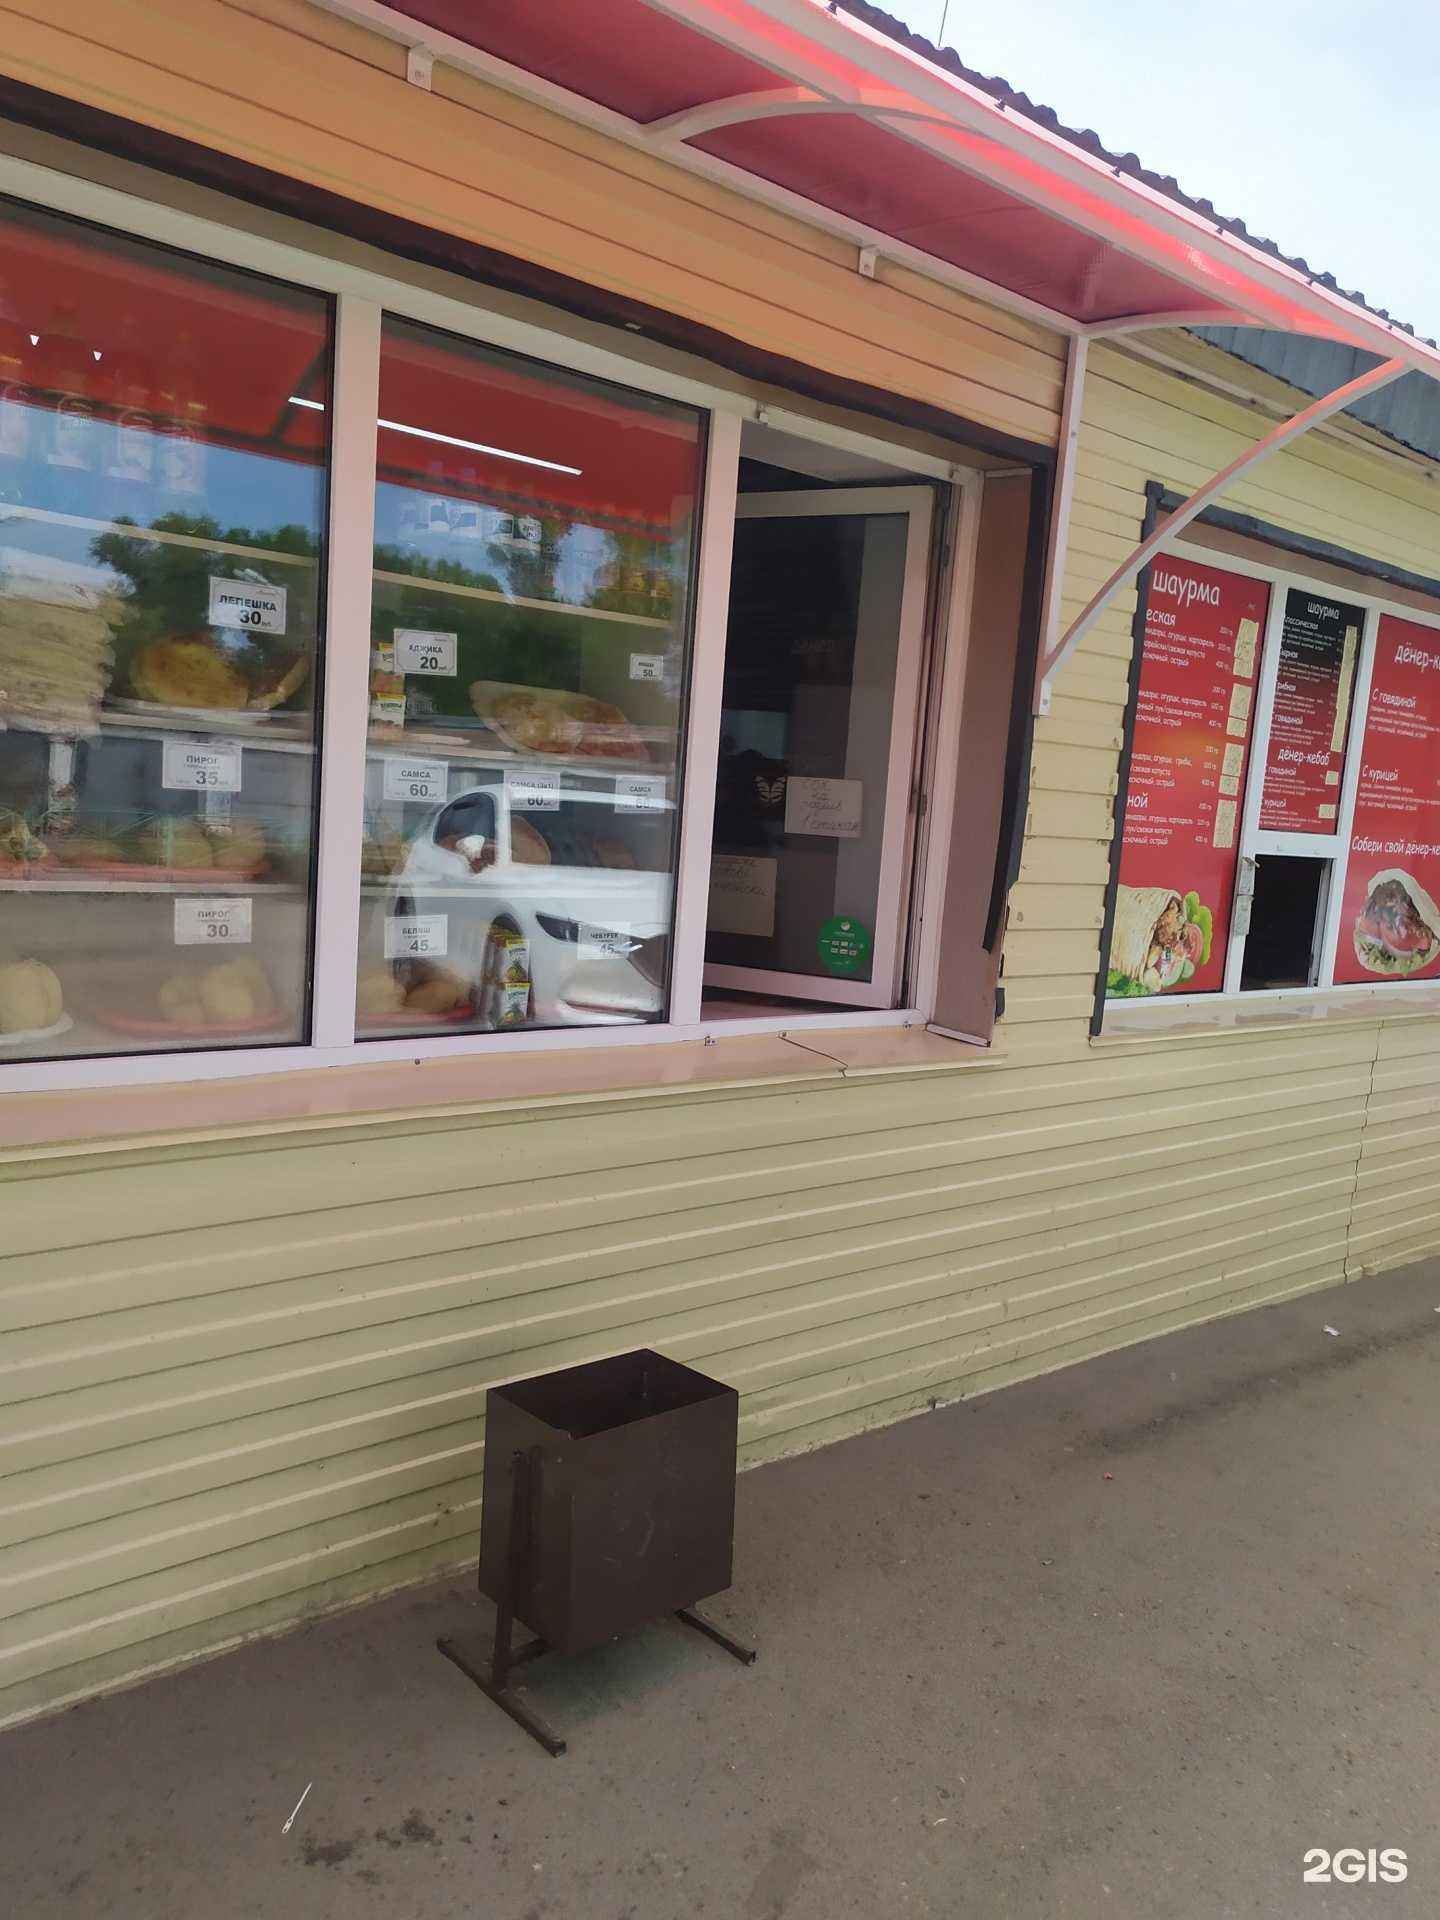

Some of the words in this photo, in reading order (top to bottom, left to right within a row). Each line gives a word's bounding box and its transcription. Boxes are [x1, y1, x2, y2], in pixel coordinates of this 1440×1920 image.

[1152, 569, 1221, 606] шаурма
[218, 595, 277, 612] ЛЕПЕШКА
[240, 610, 262, 625] 30
[1307, 601, 1341, 622] шаурма
[420, 656, 438, 670] 20
[1371, 688, 1379, 701] С
[186, 754, 217, 765] ПИРОГ
[195, 770, 219, 786] 35
[401, 769, 431, 778] САМСА
[409, 783, 429, 798] 60
[1351, 835, 1383, 857] Собери
[1385, 838, 1405, 854] свой
[198, 910, 230, 918] ПИРОГ
[207, 923, 229, 938] 30
[408, 939, 430, 952] 45
